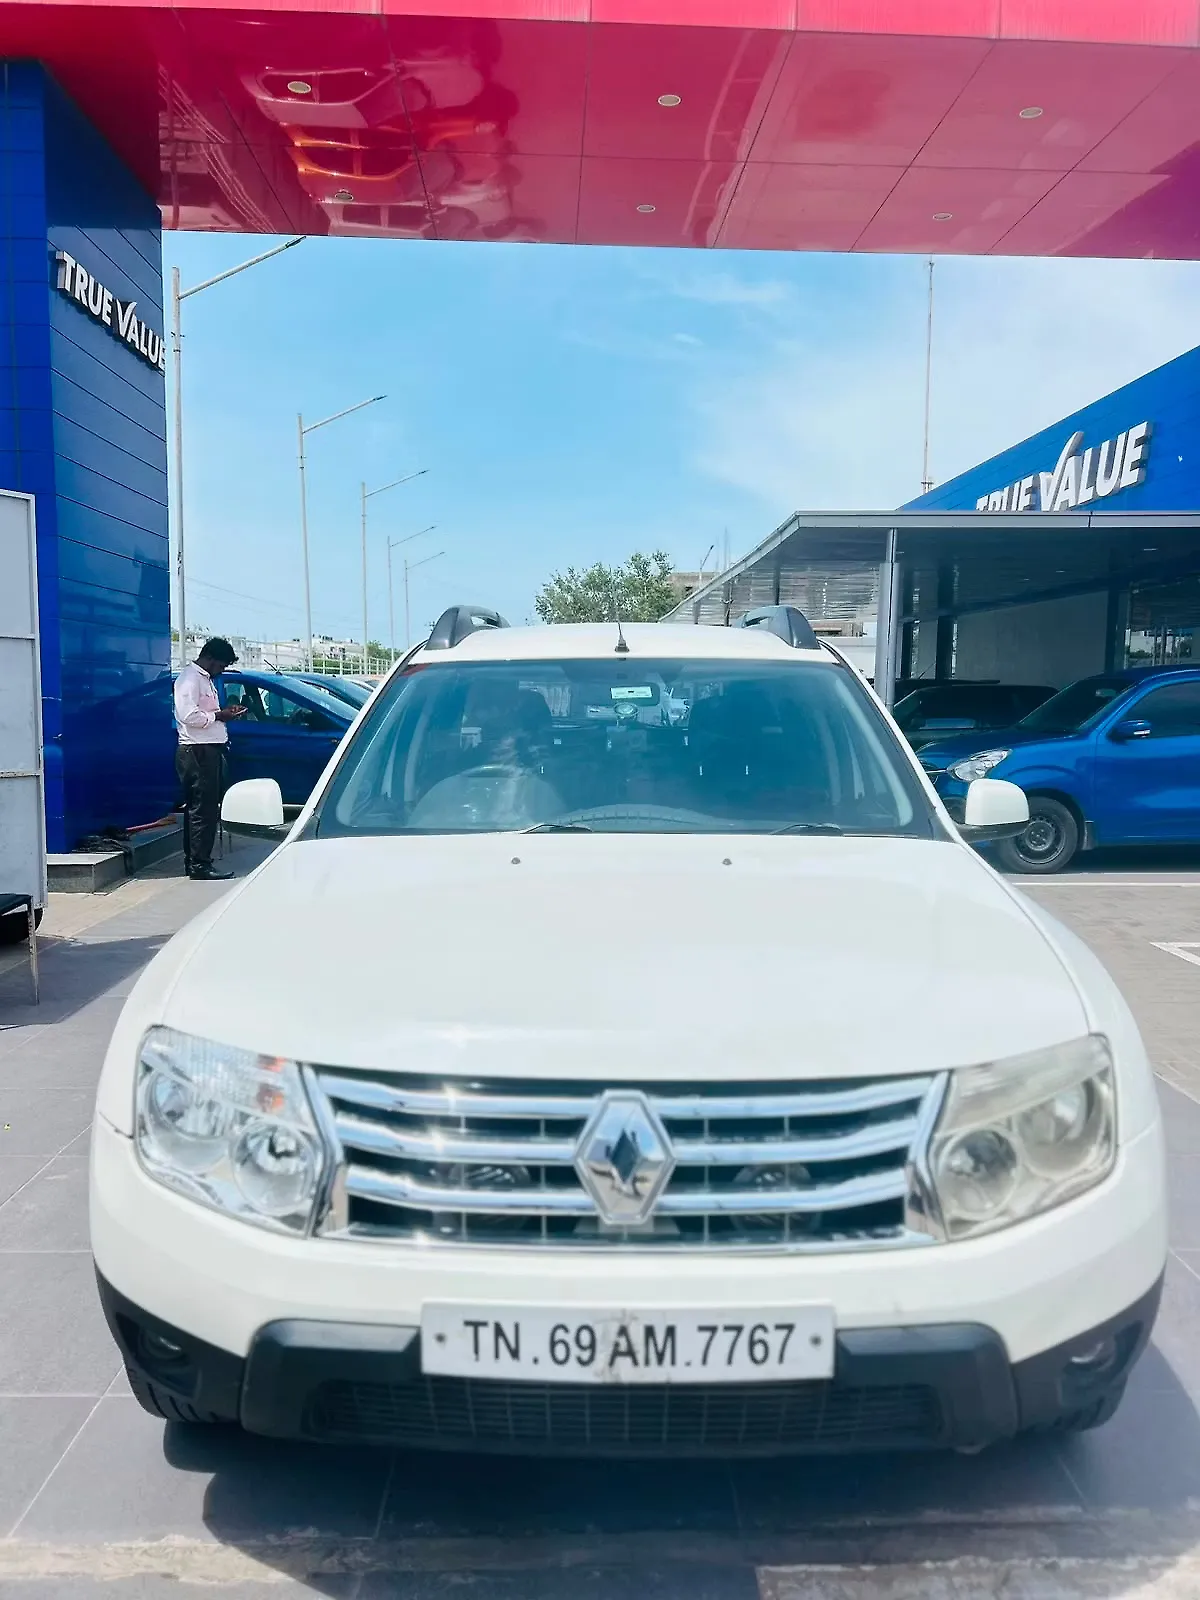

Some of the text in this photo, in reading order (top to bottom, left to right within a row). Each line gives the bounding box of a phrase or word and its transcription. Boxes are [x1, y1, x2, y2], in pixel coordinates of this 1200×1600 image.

[56, 251, 166, 371] TRUE VALUE
[1039, 421, 1149, 512] VALUE
